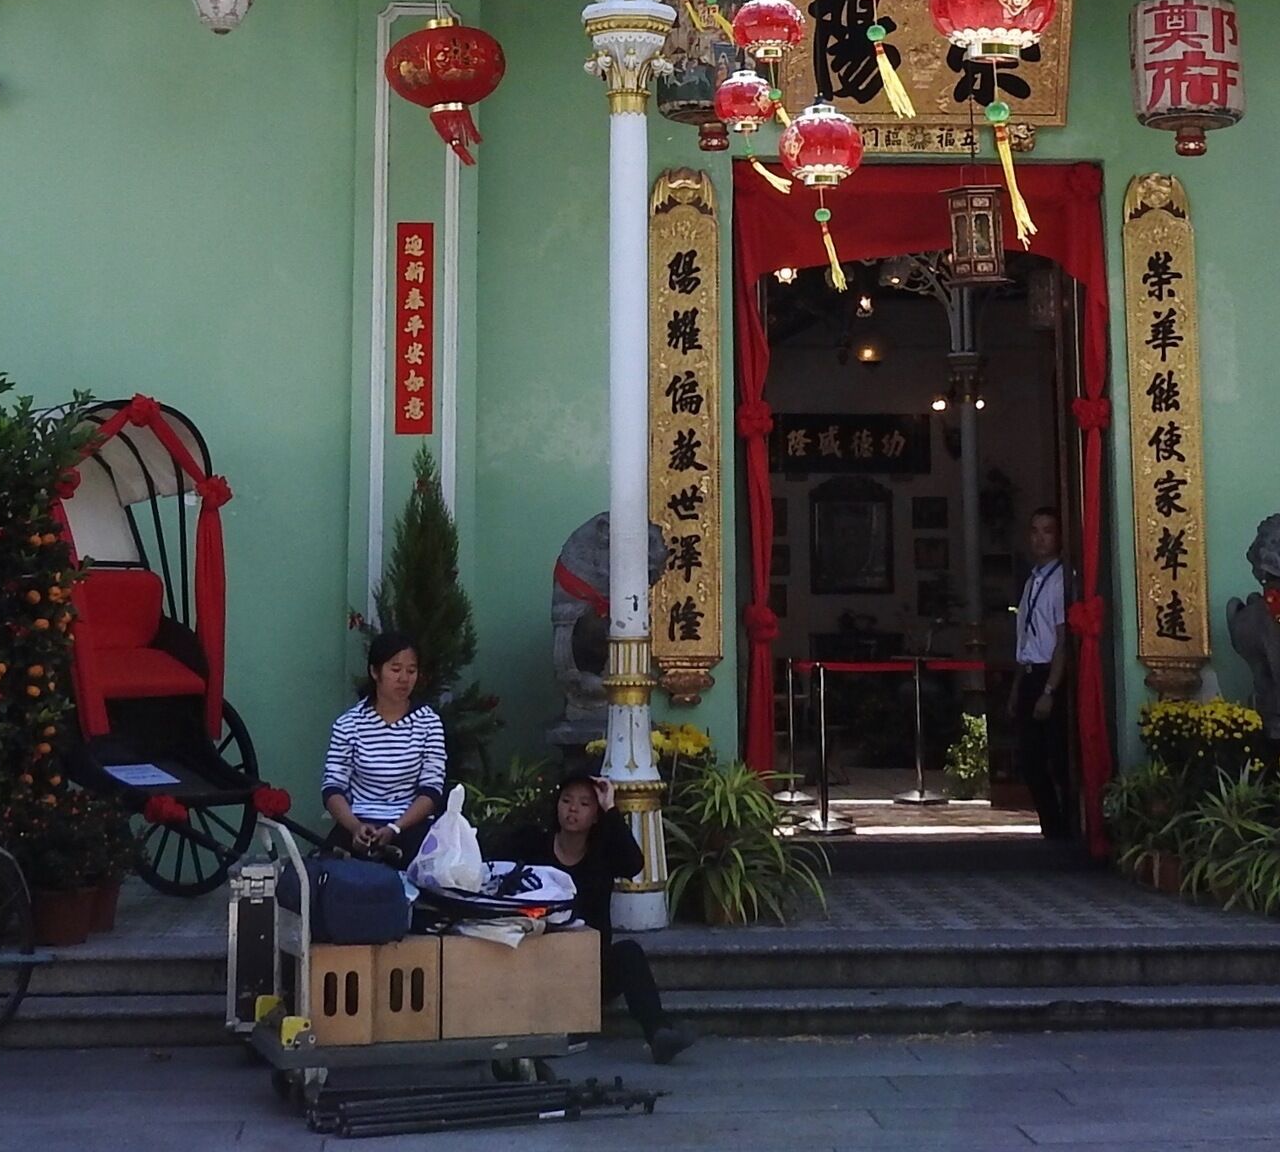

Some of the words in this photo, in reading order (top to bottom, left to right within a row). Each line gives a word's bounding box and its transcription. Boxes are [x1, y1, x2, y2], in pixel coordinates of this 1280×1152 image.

[403, 233, 426, 421] 迎新春平安如意
[1142, 250, 1193, 642] 榮華能使家聲遠
